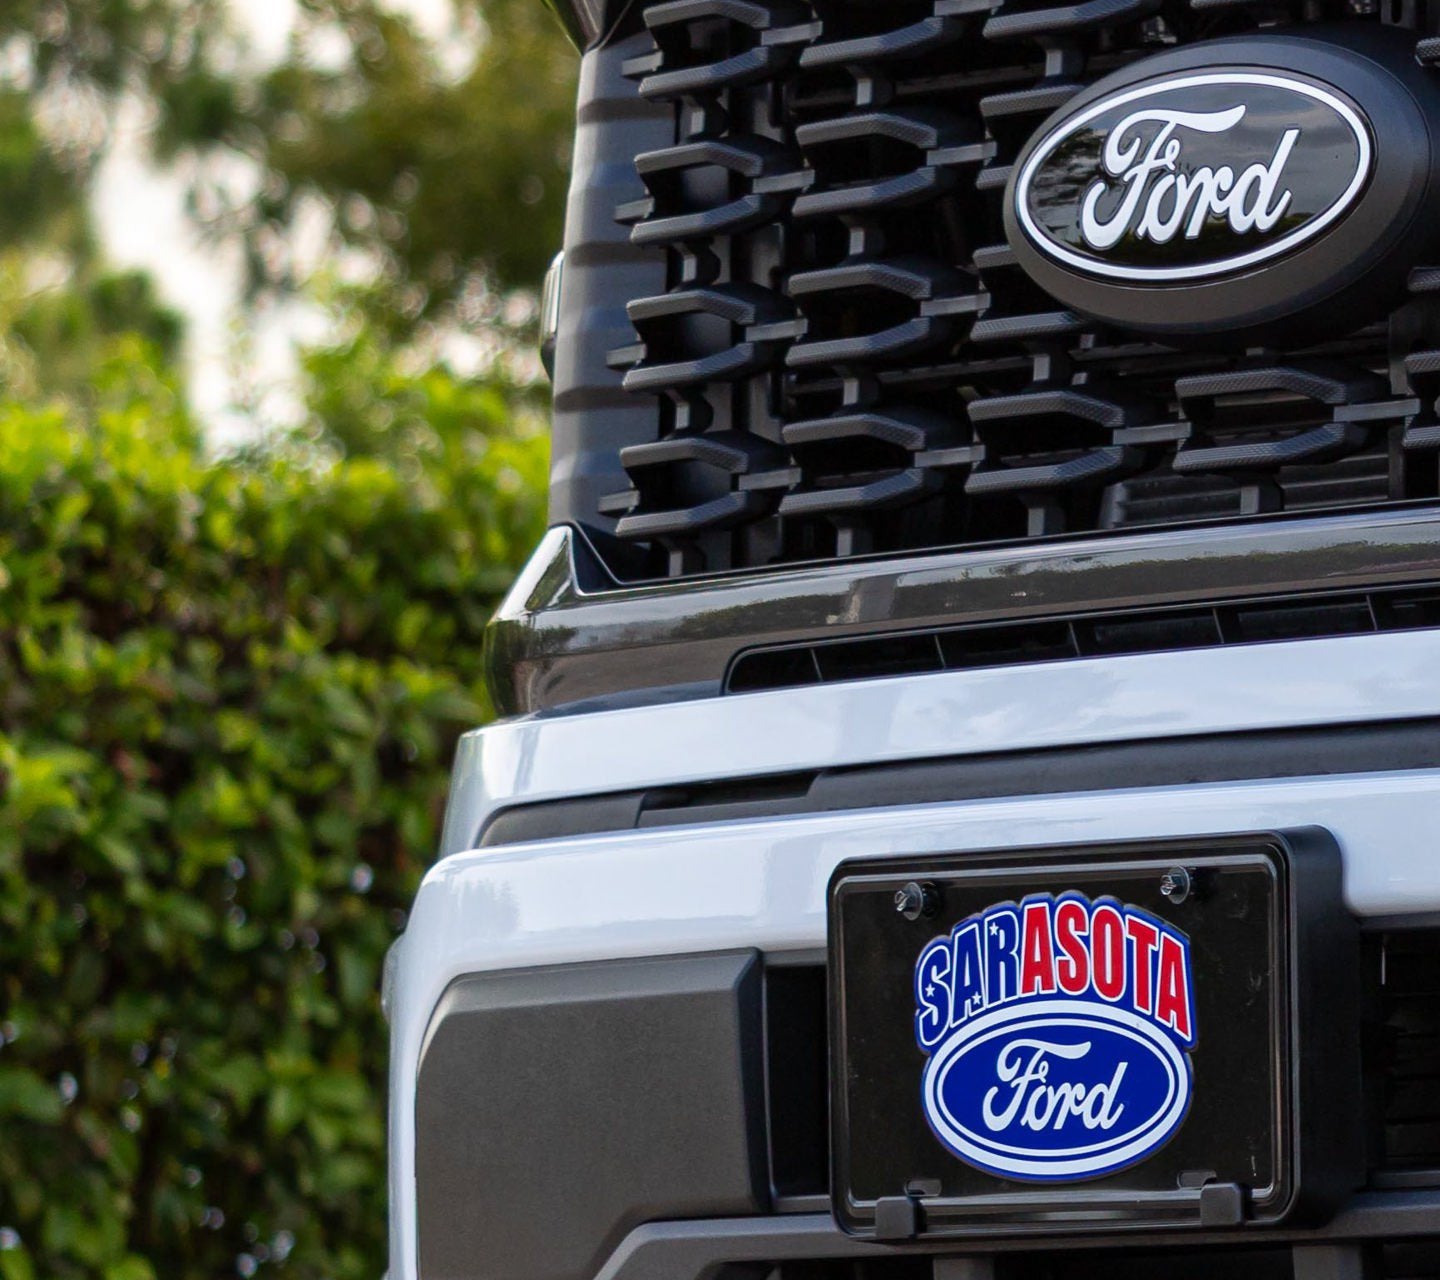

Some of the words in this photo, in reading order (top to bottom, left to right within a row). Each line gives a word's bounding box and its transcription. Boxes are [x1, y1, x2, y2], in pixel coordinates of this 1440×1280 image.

[1081, 104, 1300, 250] Ford
[918, 899, 1194, 1047] SARASOTA
[982, 1037, 1129, 1132] Ford
